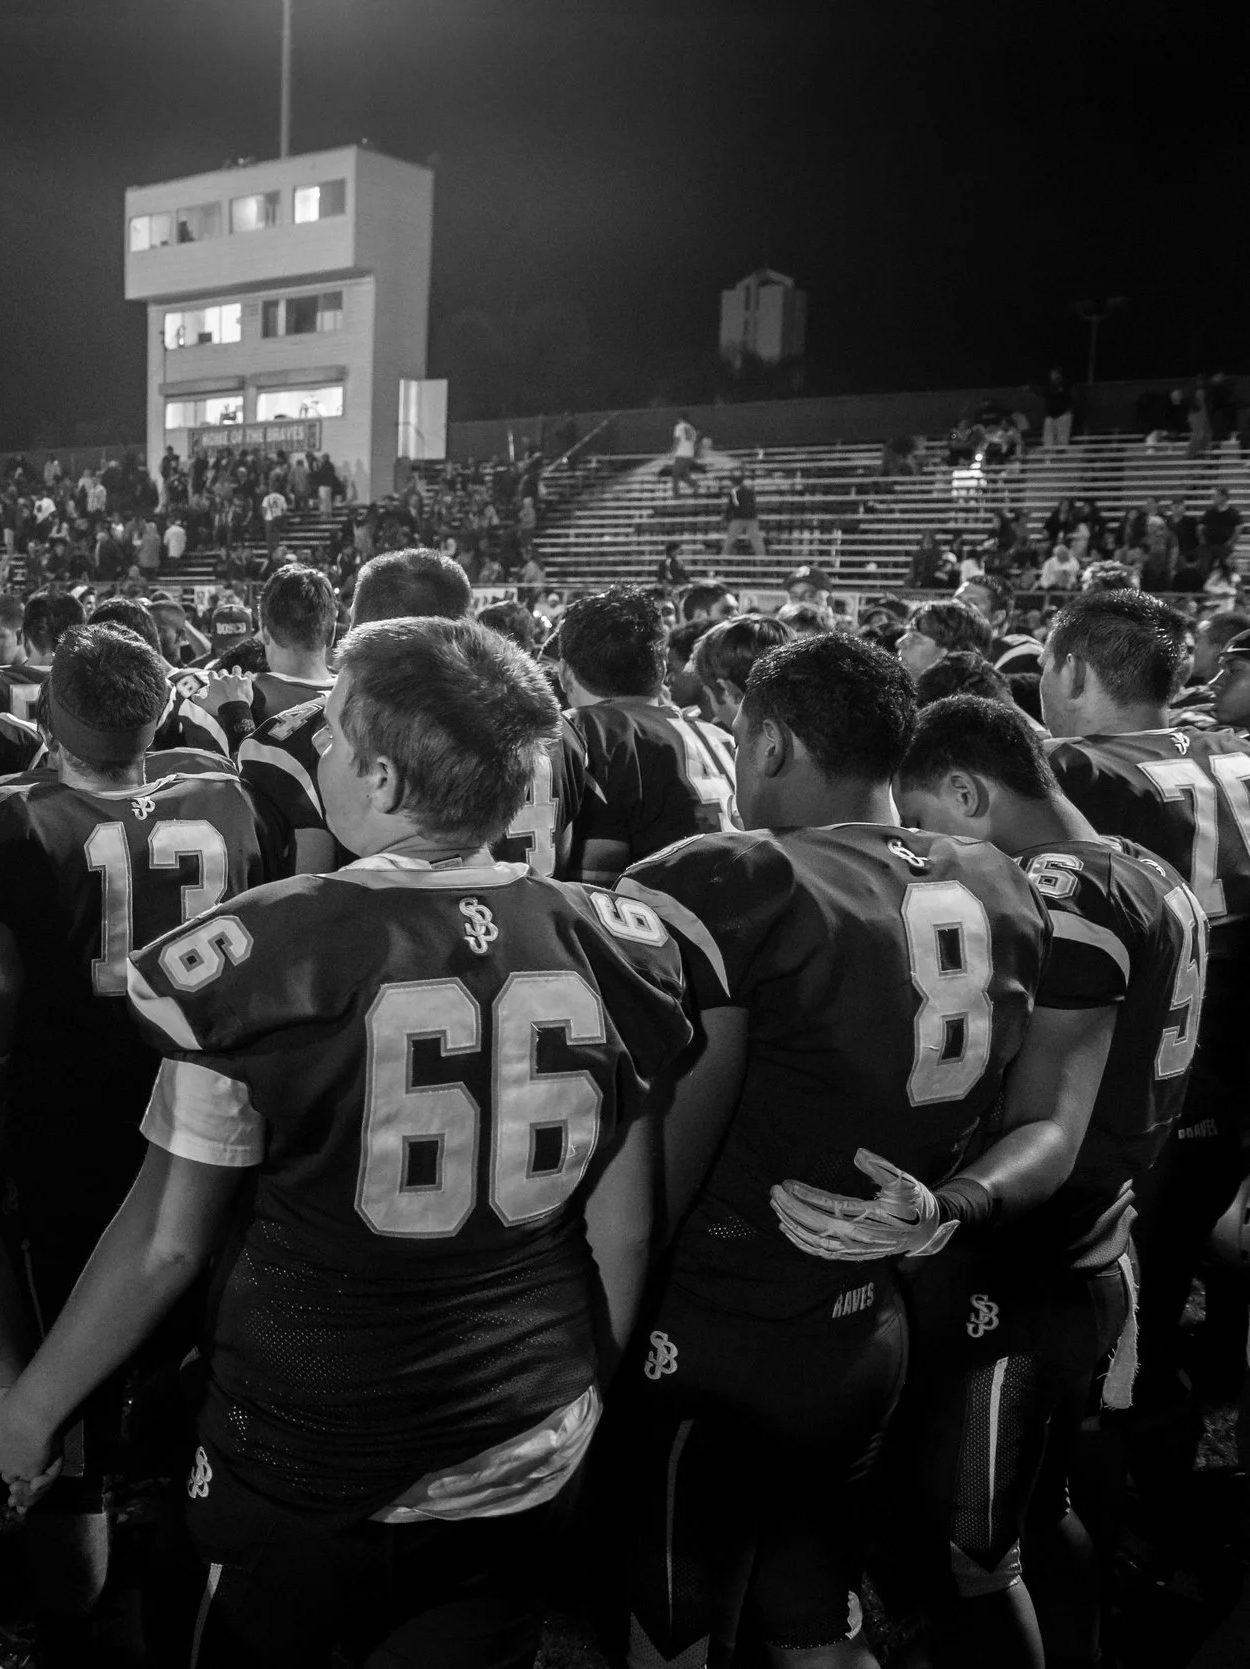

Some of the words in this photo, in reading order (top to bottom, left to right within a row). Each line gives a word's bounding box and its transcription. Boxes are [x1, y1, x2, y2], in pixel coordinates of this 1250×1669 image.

[1012, 853, 1084, 899] 6
[158, 915, 254, 992] 6
[590, 892, 669, 947] 6
[901, 880, 993, 1107] 8
[354, 970, 606, 1239] 66
